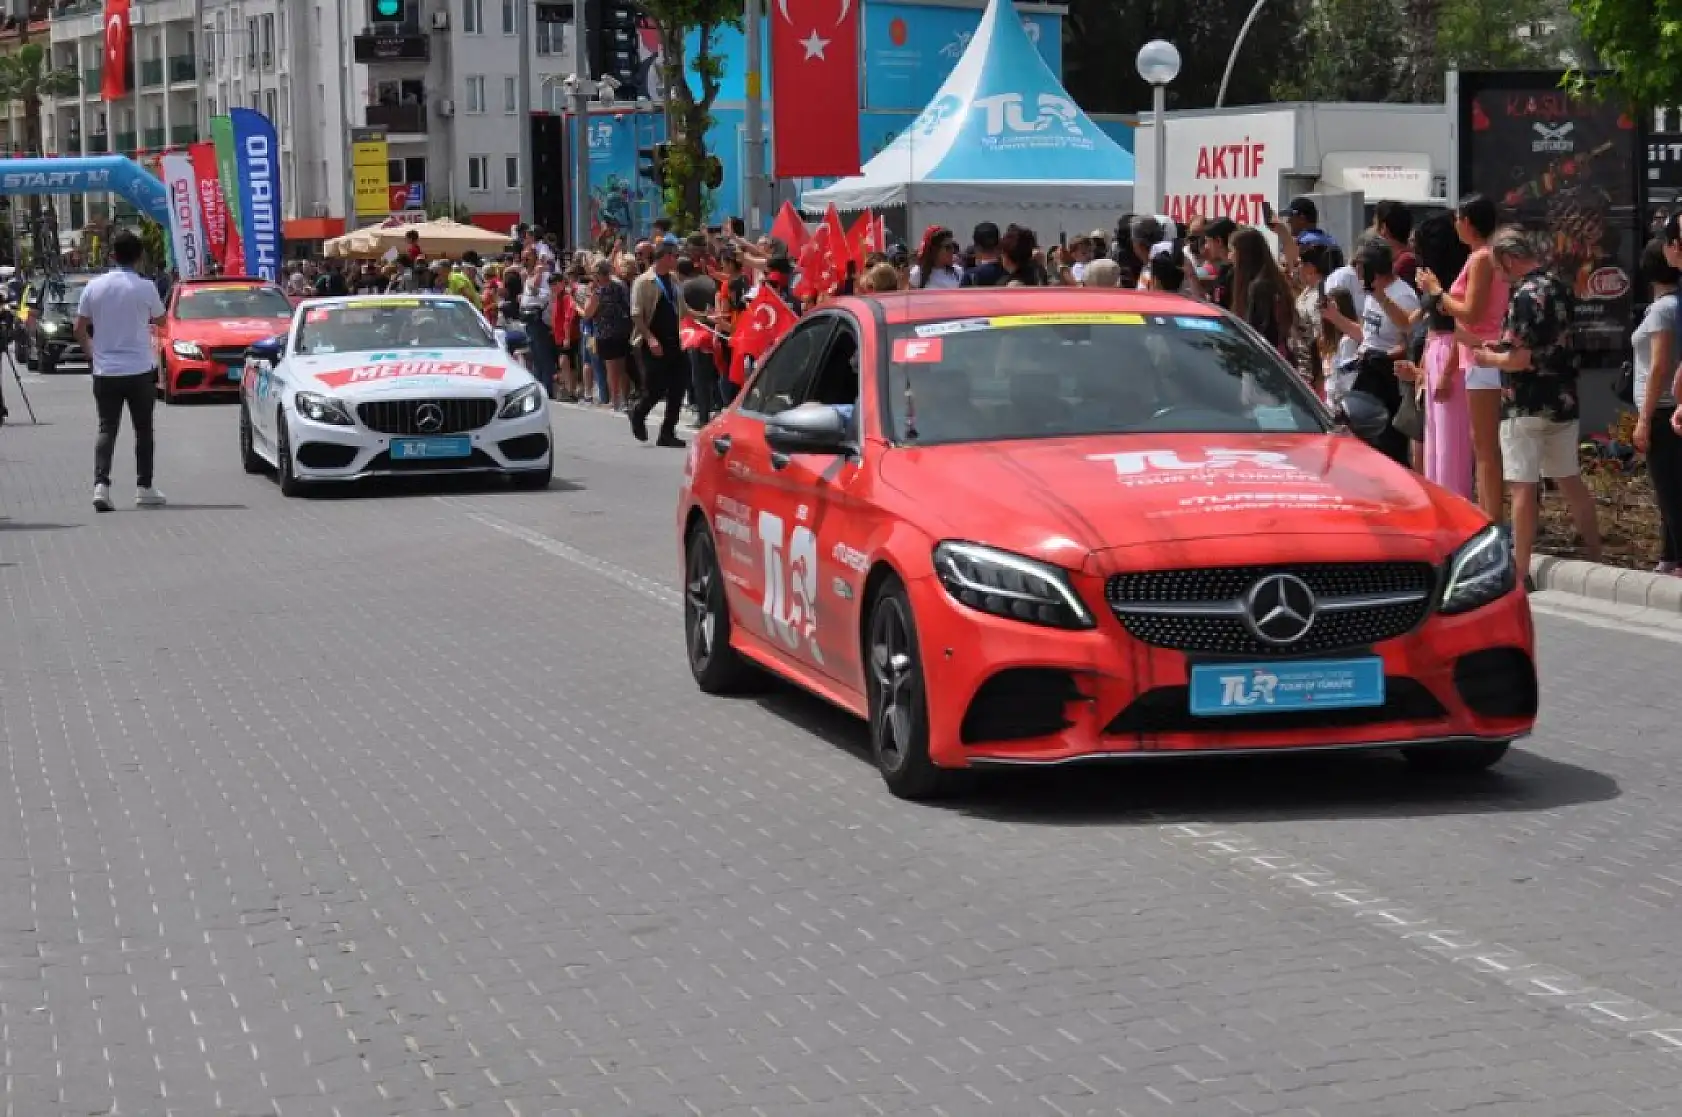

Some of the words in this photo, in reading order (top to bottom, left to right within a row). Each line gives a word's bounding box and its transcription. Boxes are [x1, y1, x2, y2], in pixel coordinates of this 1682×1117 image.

[1195, 134, 1265, 180] AKTİF
[3, 171, 80, 187] START
[905, 341, 931, 359] F
[350, 360, 483, 381] MEDICAL
